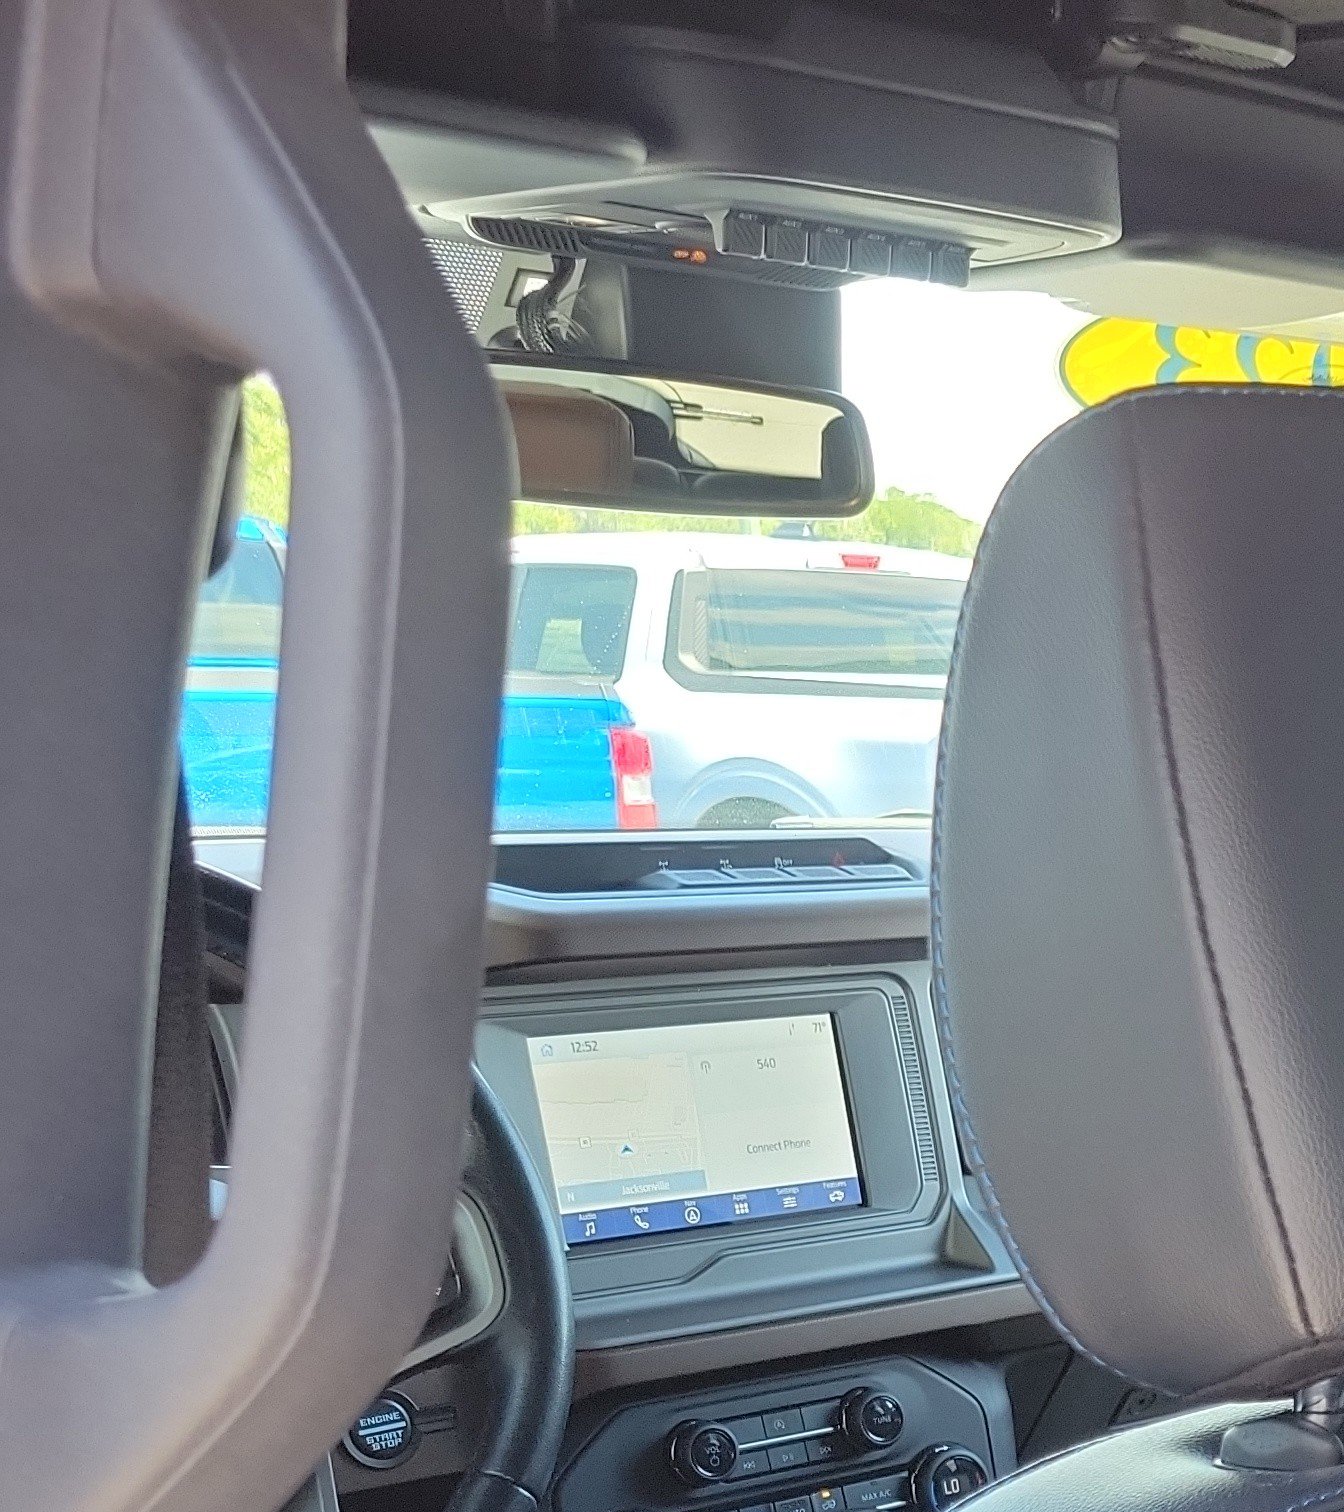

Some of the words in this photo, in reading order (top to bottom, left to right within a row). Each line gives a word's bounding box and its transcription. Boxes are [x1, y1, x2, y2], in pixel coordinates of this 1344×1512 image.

[571, 1040, 598, 1053] 12:52
[757, 1058, 776, 1070] 540
[746, 1142, 782, 1154] Connect
[784, 1139, 811, 1149] Phone
[621, 1180, 670, 1196] Jacksonville
[630, 1206, 649, 1214] Phone
[360, 1411, 400, 1427] ENGINE
[873, 1414, 891, 1424] TUNE
[365, 1429, 404, 1444] START
[372, 1438, 402, 1451] STOP
[944, 1478, 960, 1495] LO
[861, 1493, 878, 1502] MAX
[880, 1489, 892, 1499] A/C
